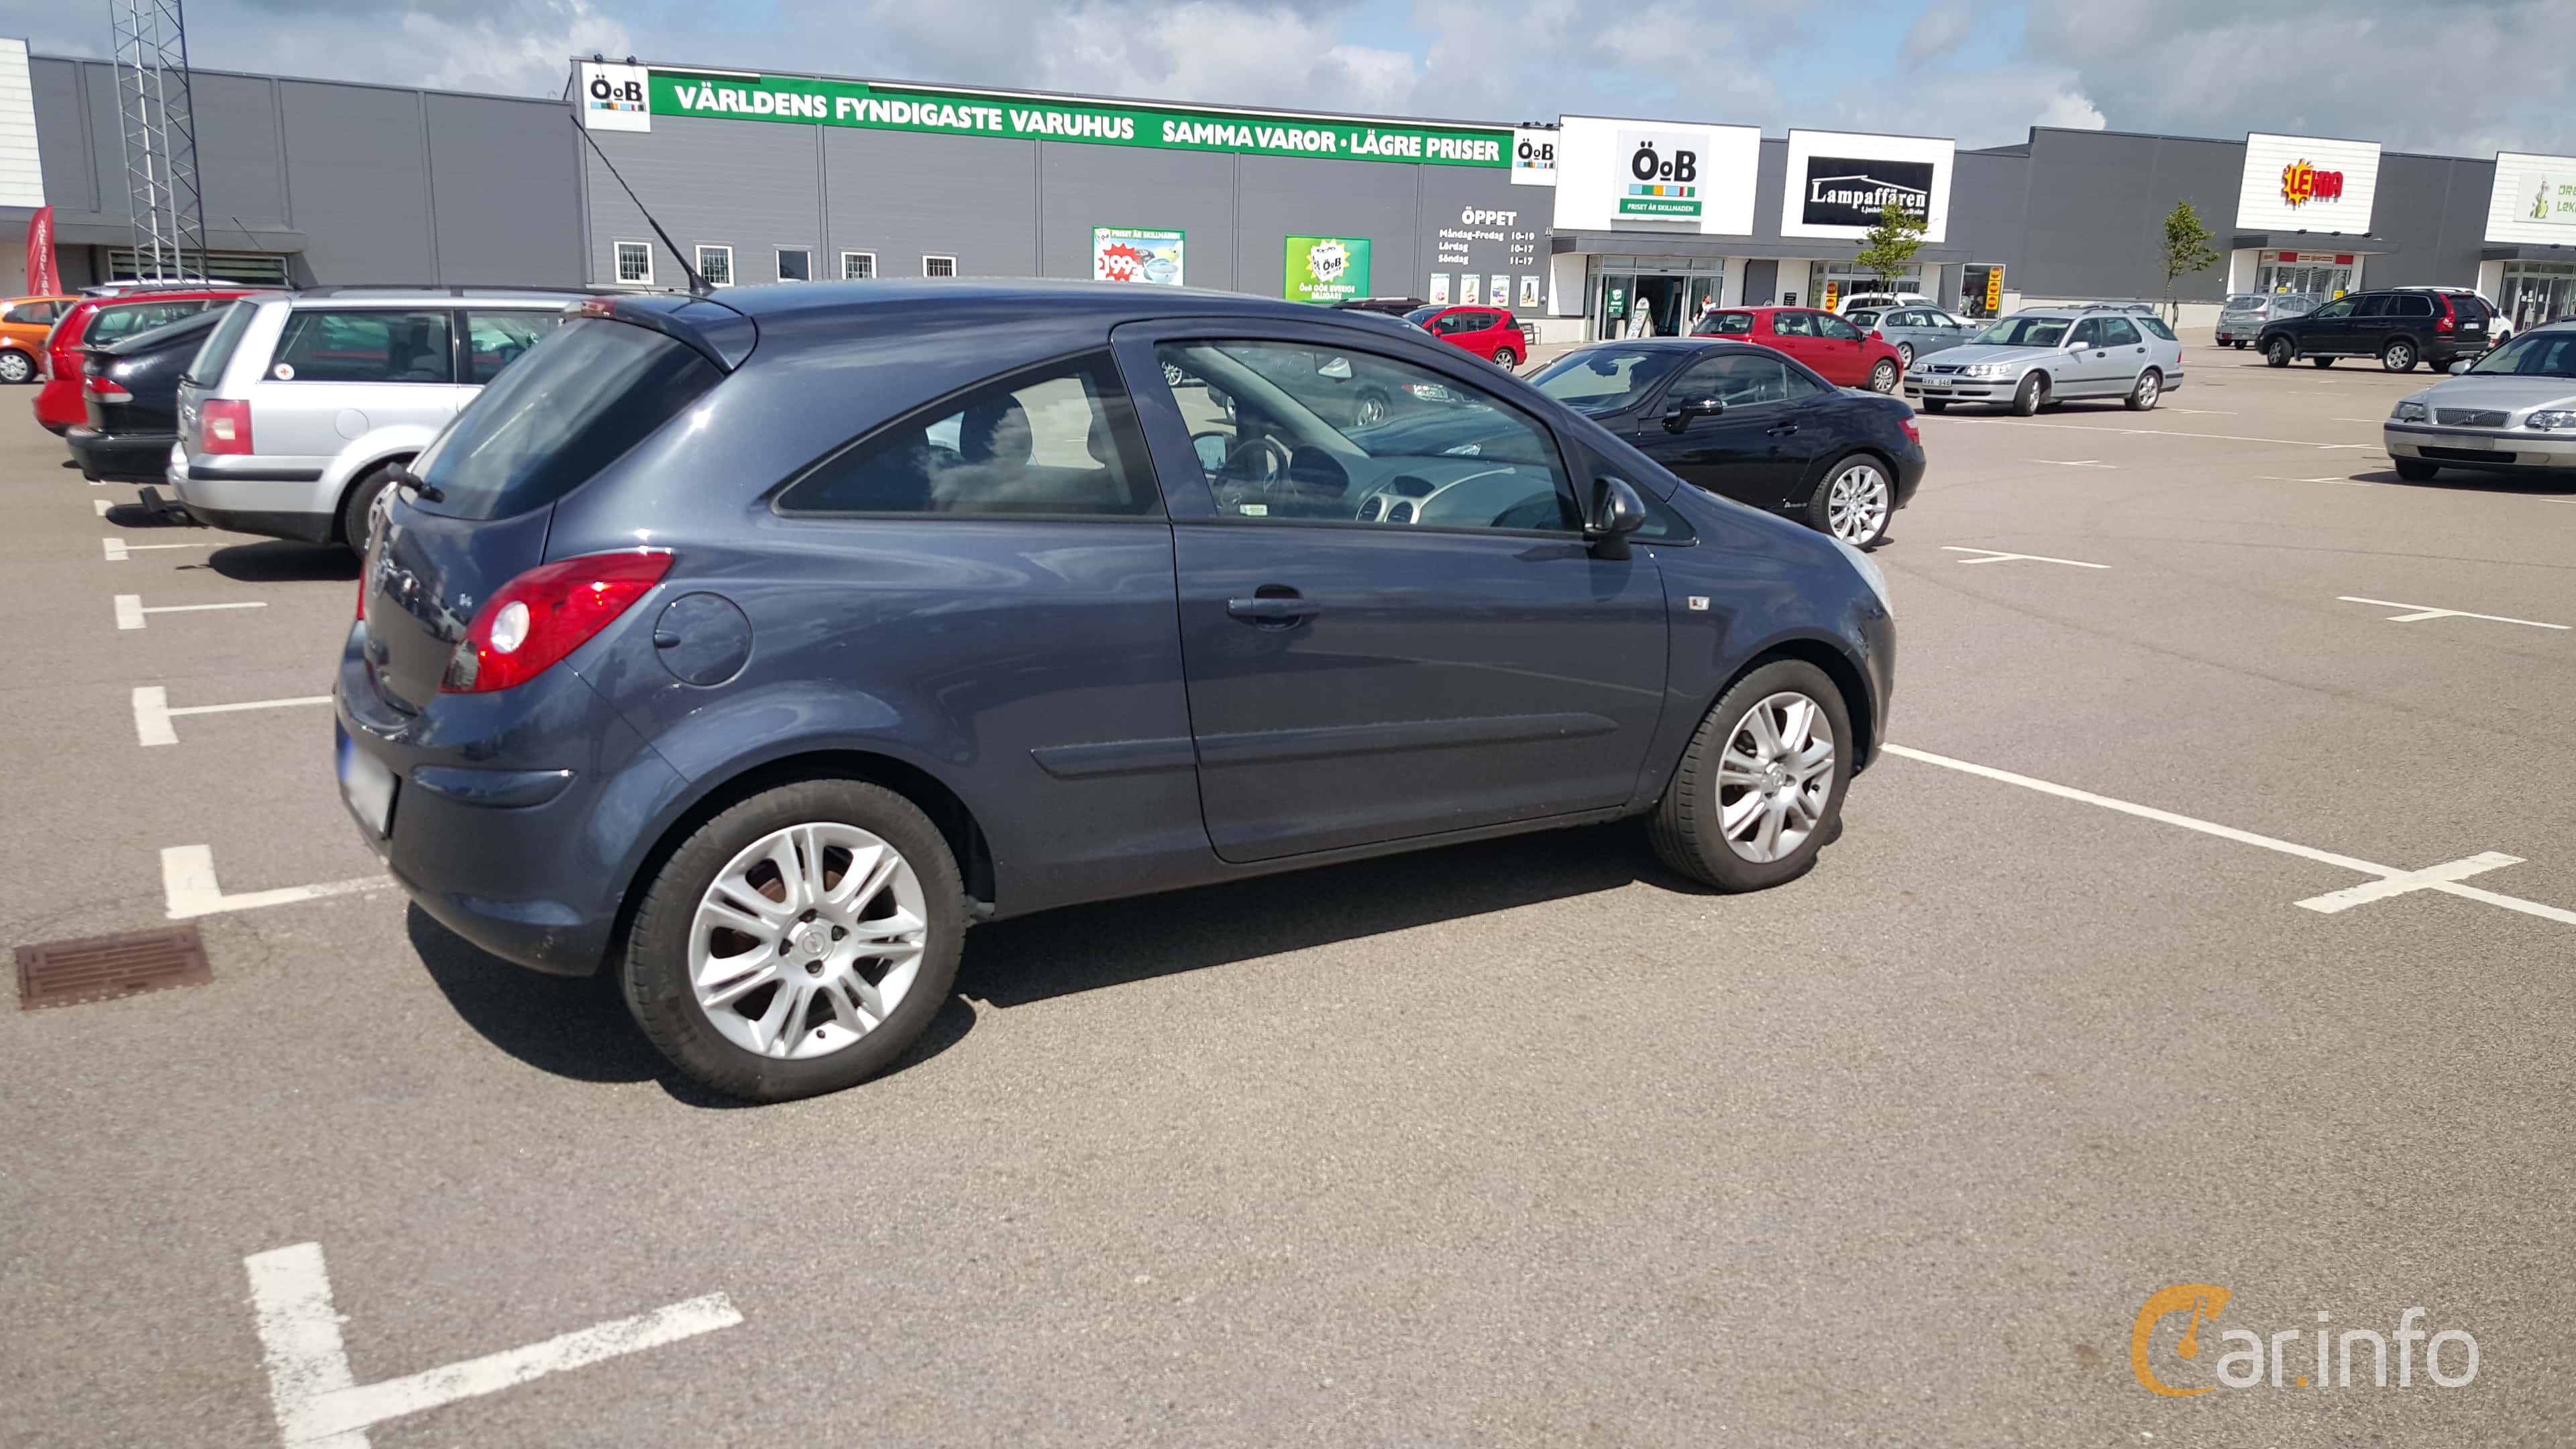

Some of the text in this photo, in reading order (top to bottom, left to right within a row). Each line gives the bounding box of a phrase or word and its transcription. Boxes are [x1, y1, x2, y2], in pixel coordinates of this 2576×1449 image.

[590, 74, 643, 101] ÖoB
[674, 82, 1134, 139] VÄRLDENS FYNDIGASTE VARUHUS
[1163, 120, 1499, 161] SAMMA VAROR LÄGRE PRISER
[1517, 138, 1554, 160] ÖoB
[1632, 140, 1697, 182] ÖoB
[1810, 182, 1925, 209] Lampaffären
[1462, 206, 1517, 225] ÖPPET
[1439, 229, 1534, 241] Måndag-Fredag 10-19
[1439, 242, 1534, 252] Lördag 10-17
[1438, 254, 1468, 264] Söndag
